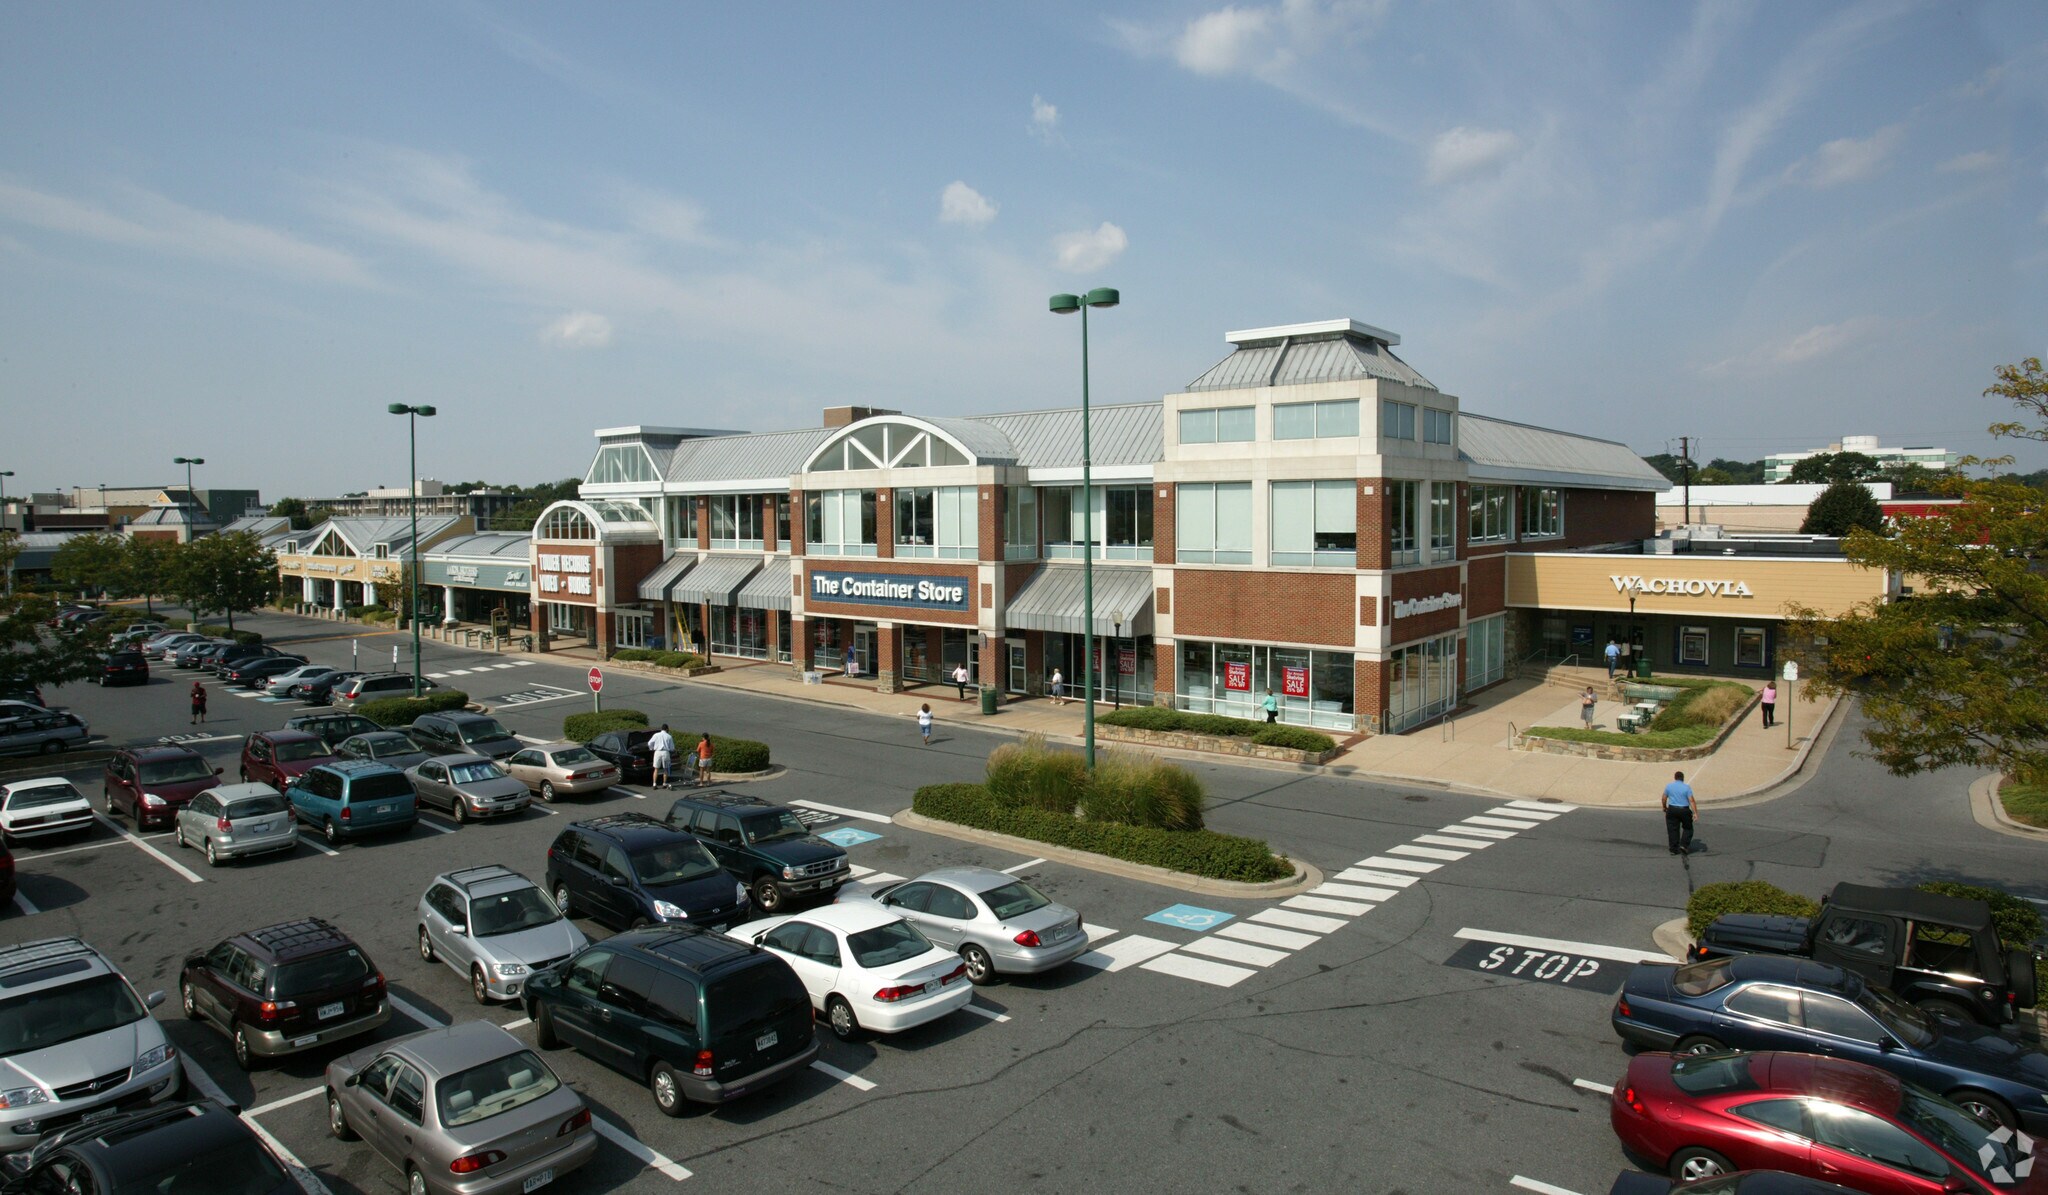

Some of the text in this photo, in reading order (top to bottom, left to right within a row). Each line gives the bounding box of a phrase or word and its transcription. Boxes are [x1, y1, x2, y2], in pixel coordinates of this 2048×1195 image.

[538, 554, 591, 574] TOWER RECORDS
[539, 574, 559, 592] VIDEO
[814, 575, 963, 602] The Container Store
[1609, 575, 1754, 596] WACHOVIA
[1120, 660, 1134, 668] SALE
[590, 675, 602, 684] STOP
[1229, 674, 1245, 683] SALE
[1286, 680, 1304, 688] SALE
[1479, 946, 1600, 983] STOP
